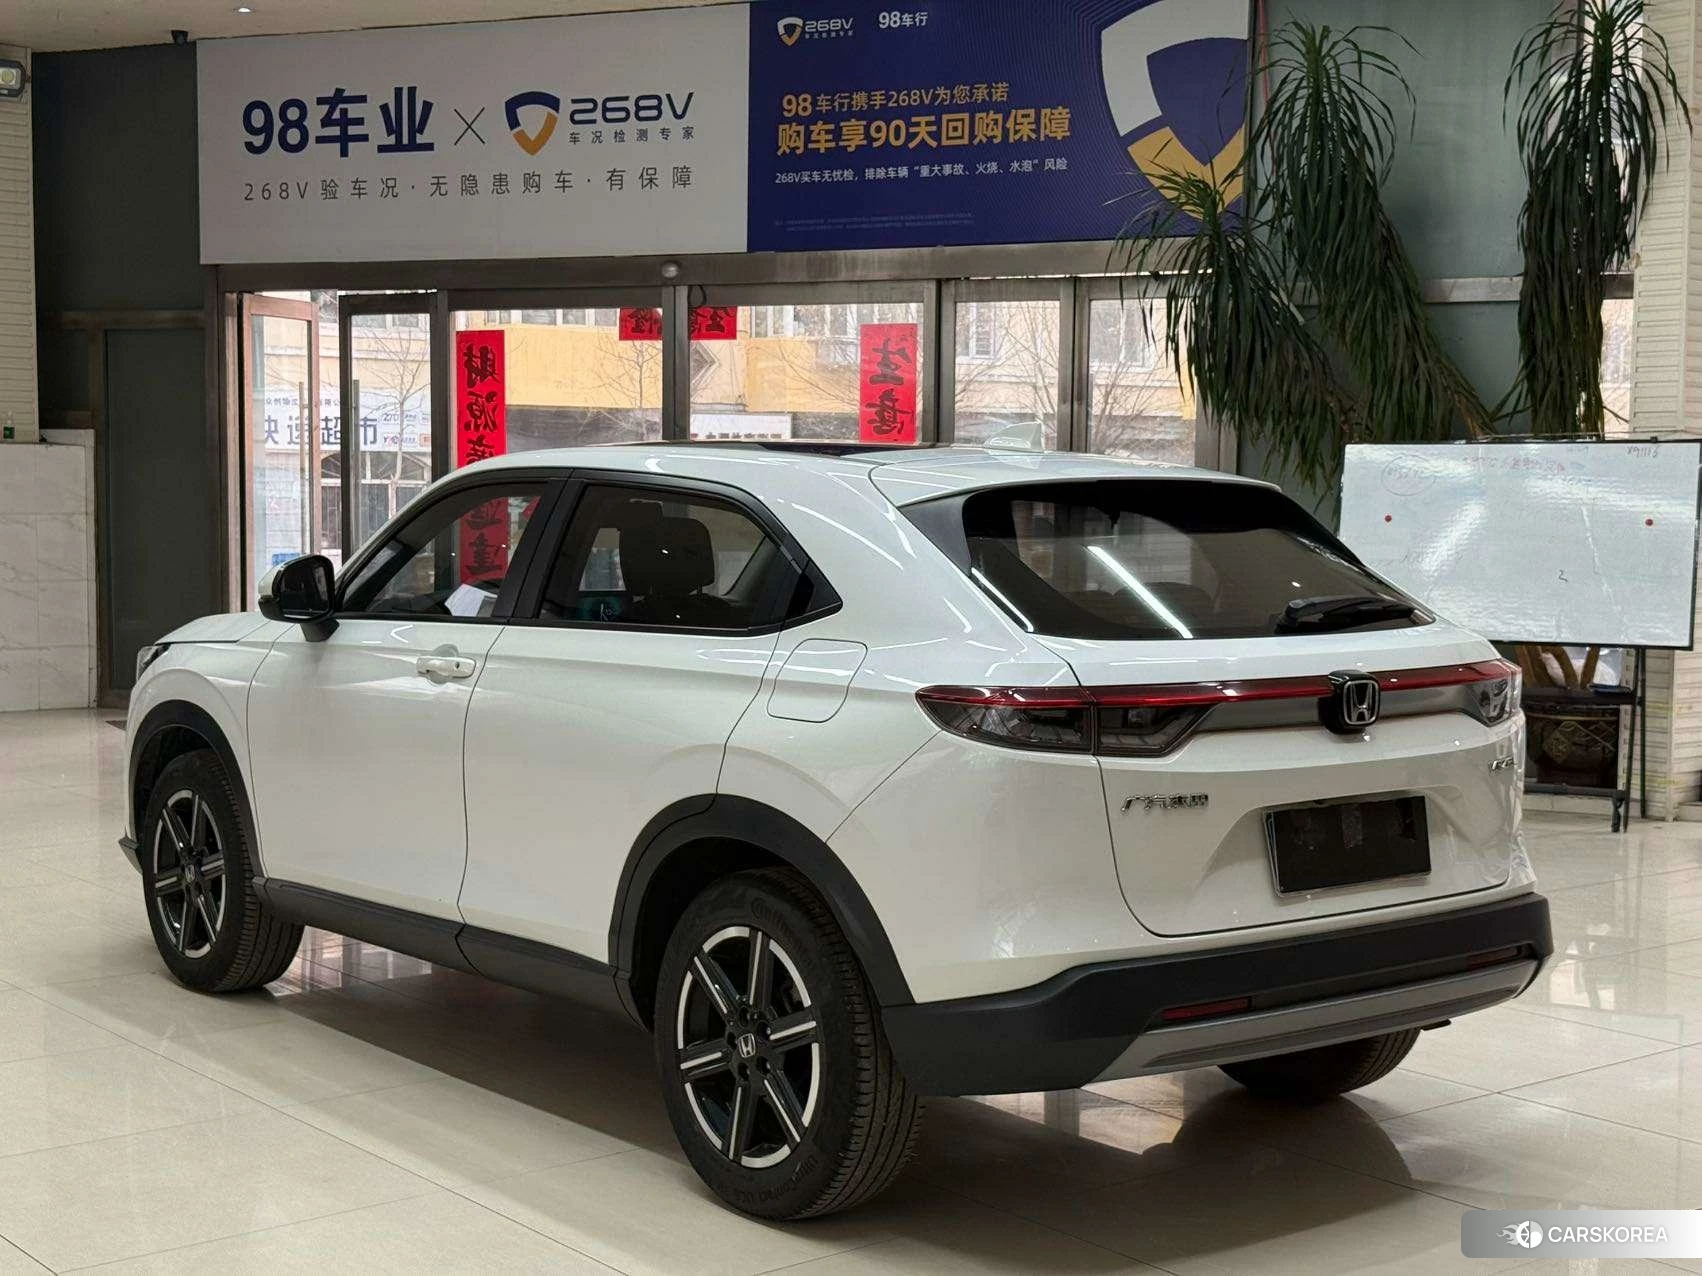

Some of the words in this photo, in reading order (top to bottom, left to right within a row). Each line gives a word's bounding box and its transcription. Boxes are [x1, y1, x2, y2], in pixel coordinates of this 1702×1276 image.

[805, 17, 853, 32] 268V
[878, 11, 928, 29] 98车行
[569, 91, 694, 125] 268V
[782, 82, 1010, 118] 98车行携手268V为您承诺
[242, 86, 435, 157] 98车业
[568, 127, 695, 145] 车况检测专家
[776, 106, 1072, 156] 购车享90天回购保障
